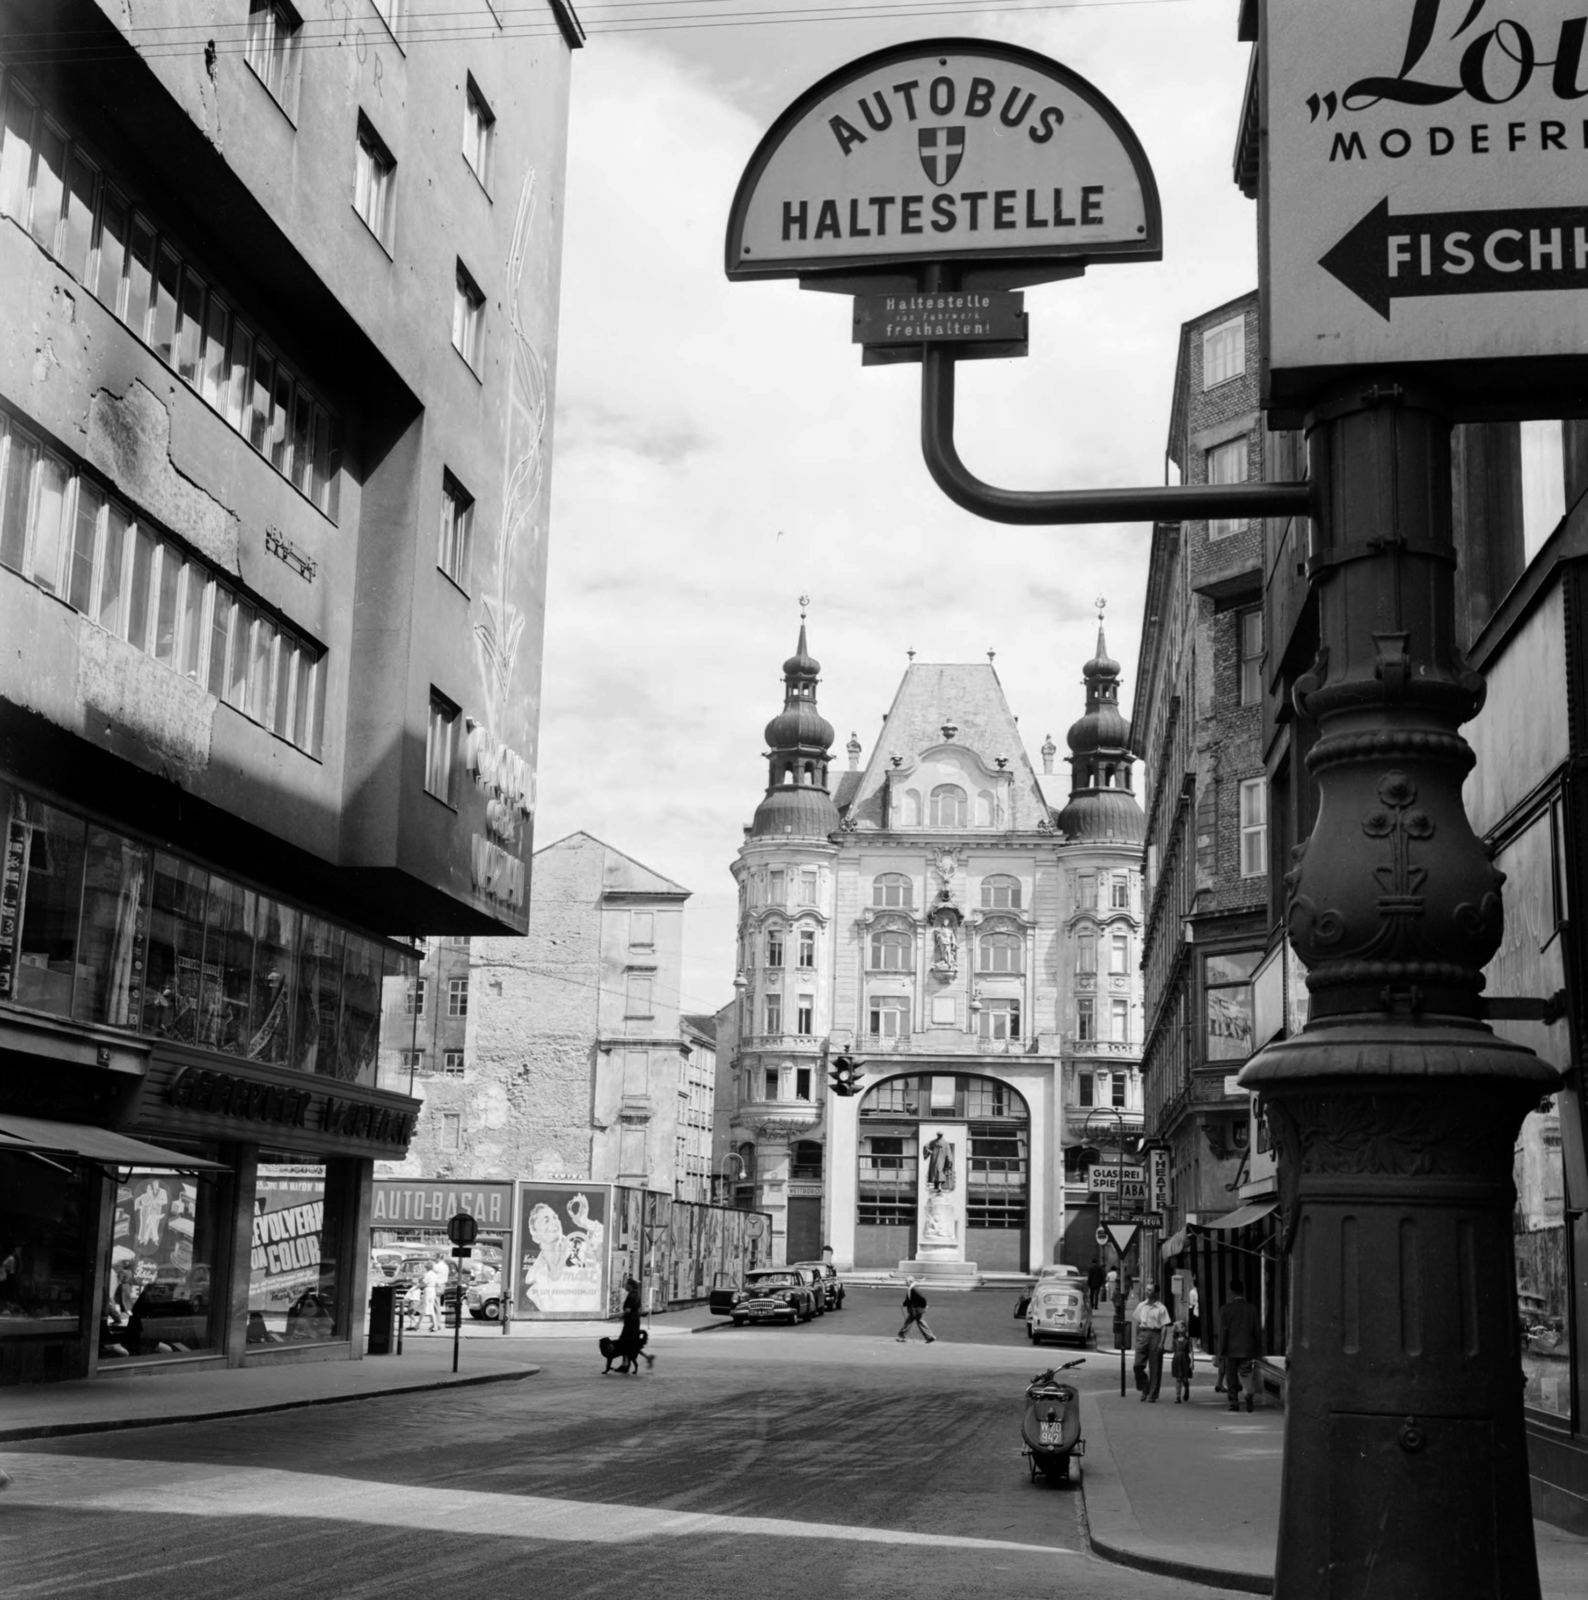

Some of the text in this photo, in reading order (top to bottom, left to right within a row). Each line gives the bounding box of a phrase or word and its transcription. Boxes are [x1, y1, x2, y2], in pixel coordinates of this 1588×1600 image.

[829, 76, 1065, 157] AUTOBUS
[781, 185, 1104, 241] HALTESTELLE
[886, 295, 990, 310] Haltestelle
[886, 321, 990, 337] freihalten!
[1093, 1169, 1140, 1179] GLASEREI
[373, 1190, 502, 1223] AUTO-BASAR
[1041, 1432, 1059, 1443] 942
